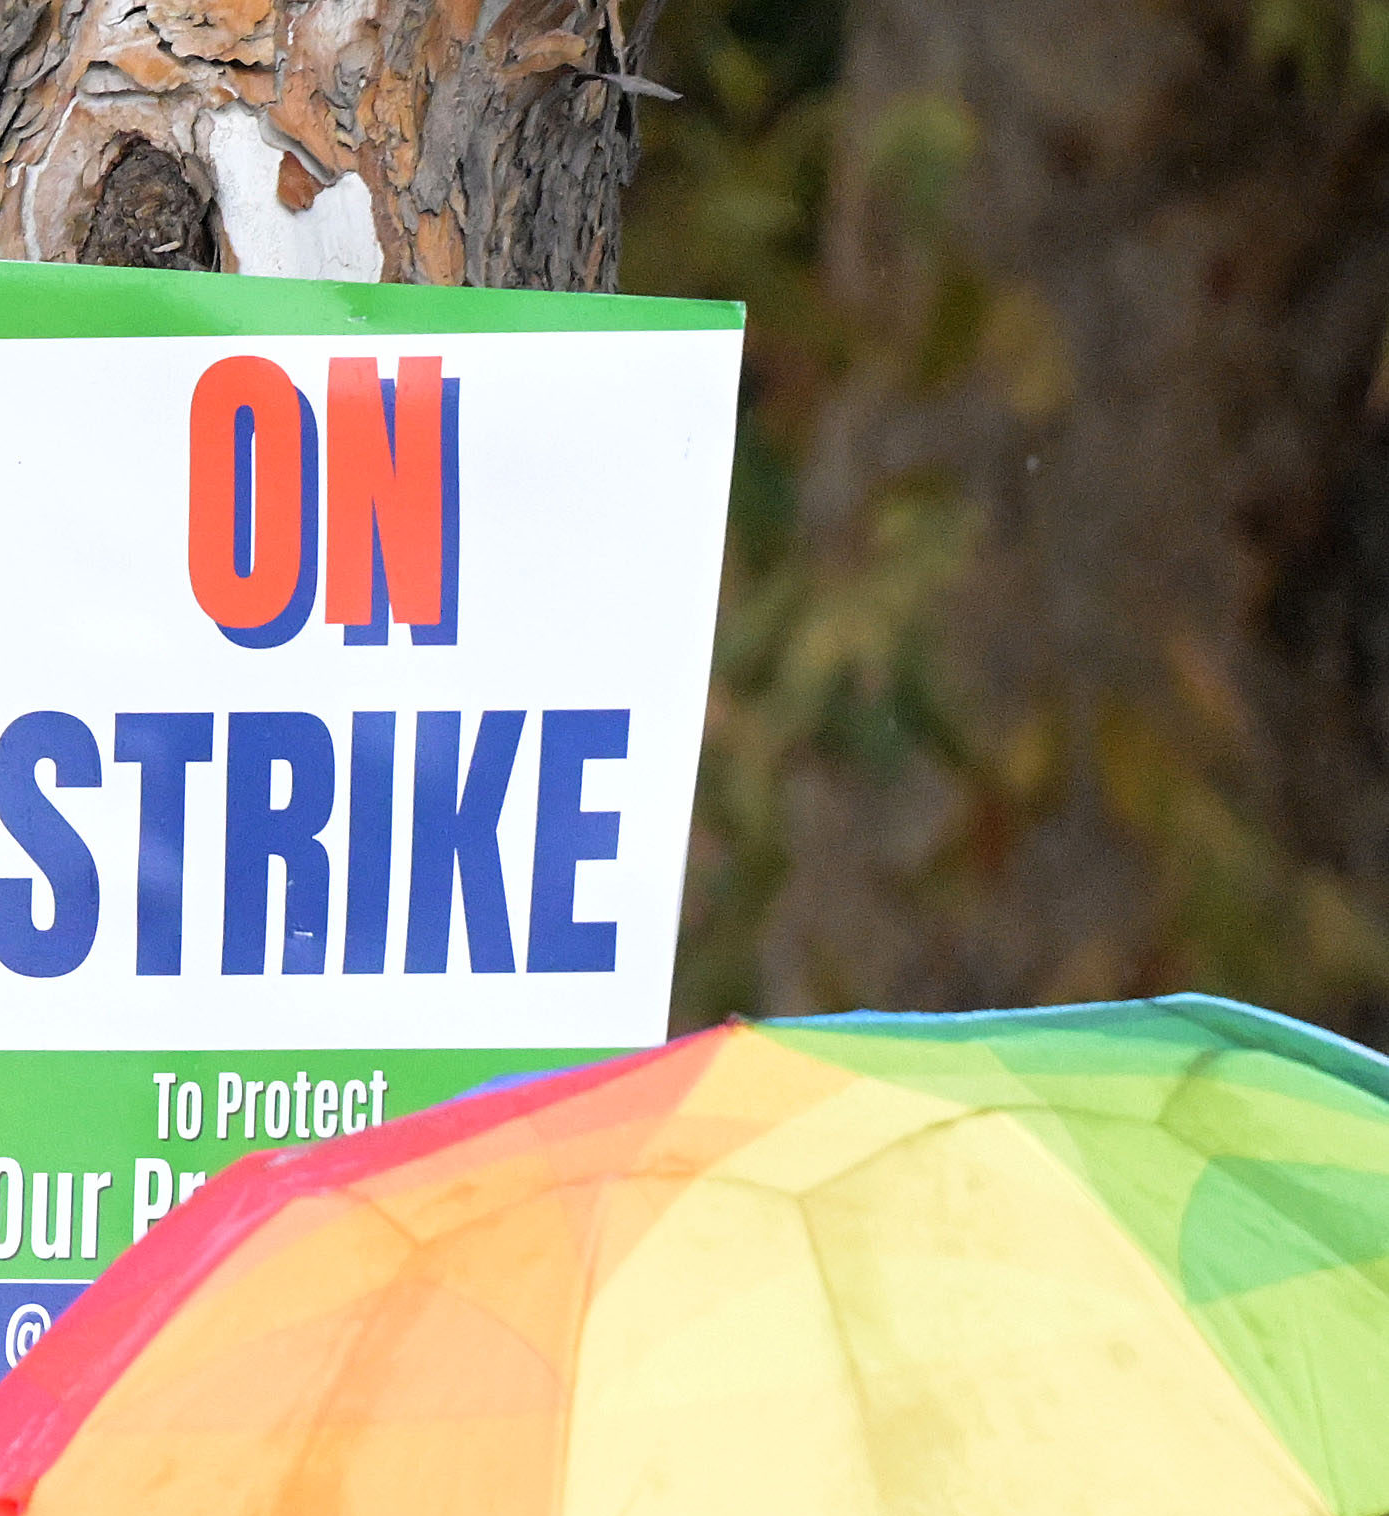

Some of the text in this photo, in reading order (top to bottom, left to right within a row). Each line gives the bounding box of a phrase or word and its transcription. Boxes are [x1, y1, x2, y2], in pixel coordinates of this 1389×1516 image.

[188, 355, 460, 649] ON
[152, 1070, 388, 1140] To Protect
